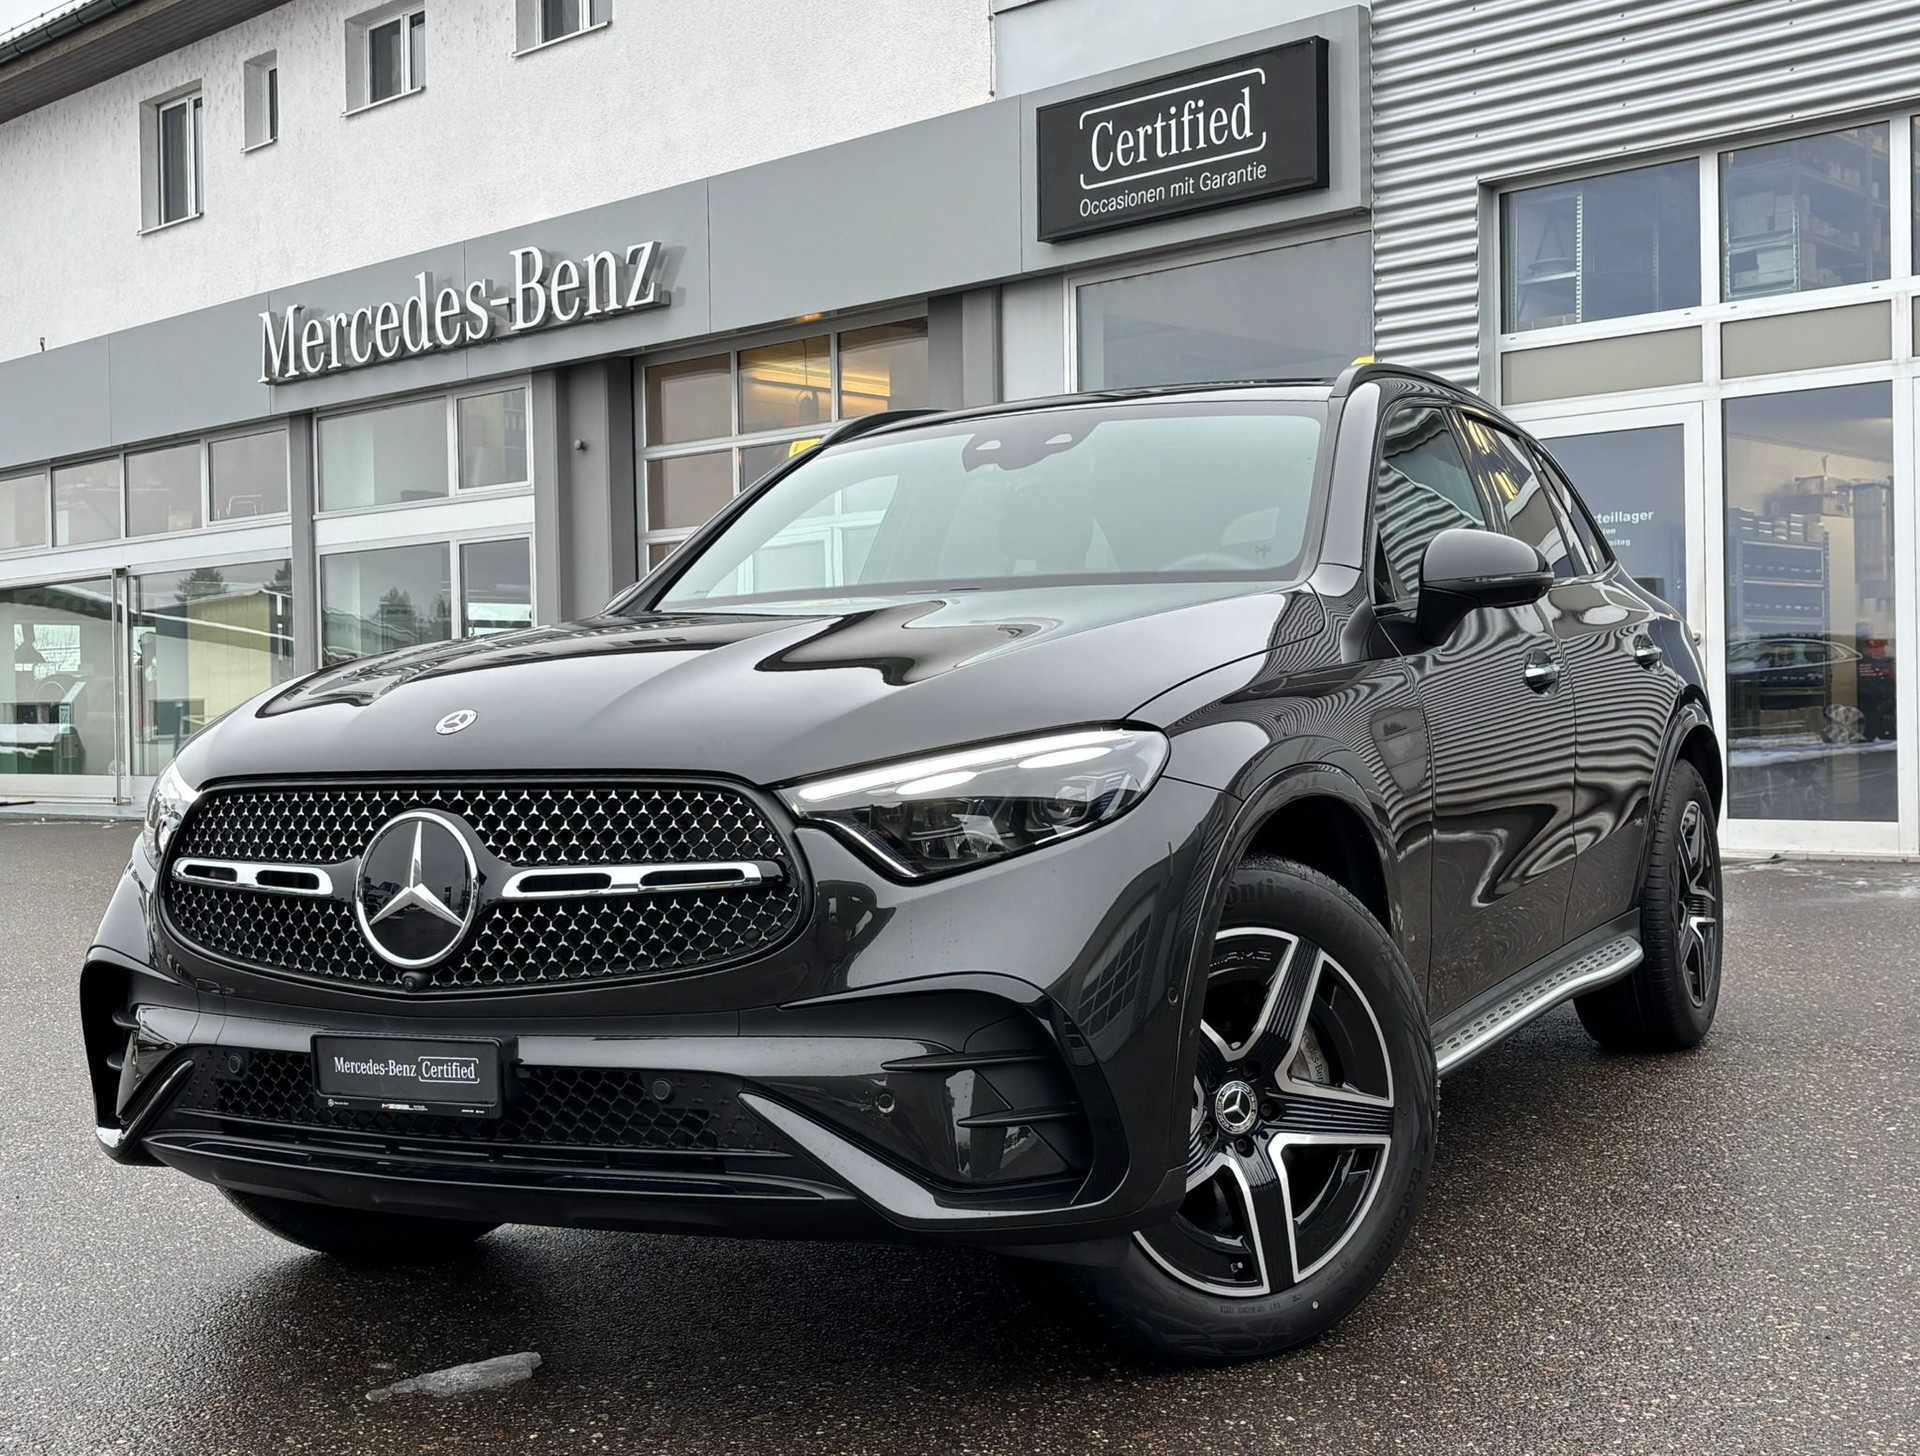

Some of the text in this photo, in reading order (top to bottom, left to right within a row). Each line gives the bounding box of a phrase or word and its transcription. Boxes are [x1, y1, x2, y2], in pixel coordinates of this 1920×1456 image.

[1091, 87, 1254, 172] Certified
[1079, 161, 1267, 217] Occasionen mit Garantie
[257, 240, 664, 384] Mercedes-Benz
[333, 1056, 476, 1079] Mercedes-Benz Certified
